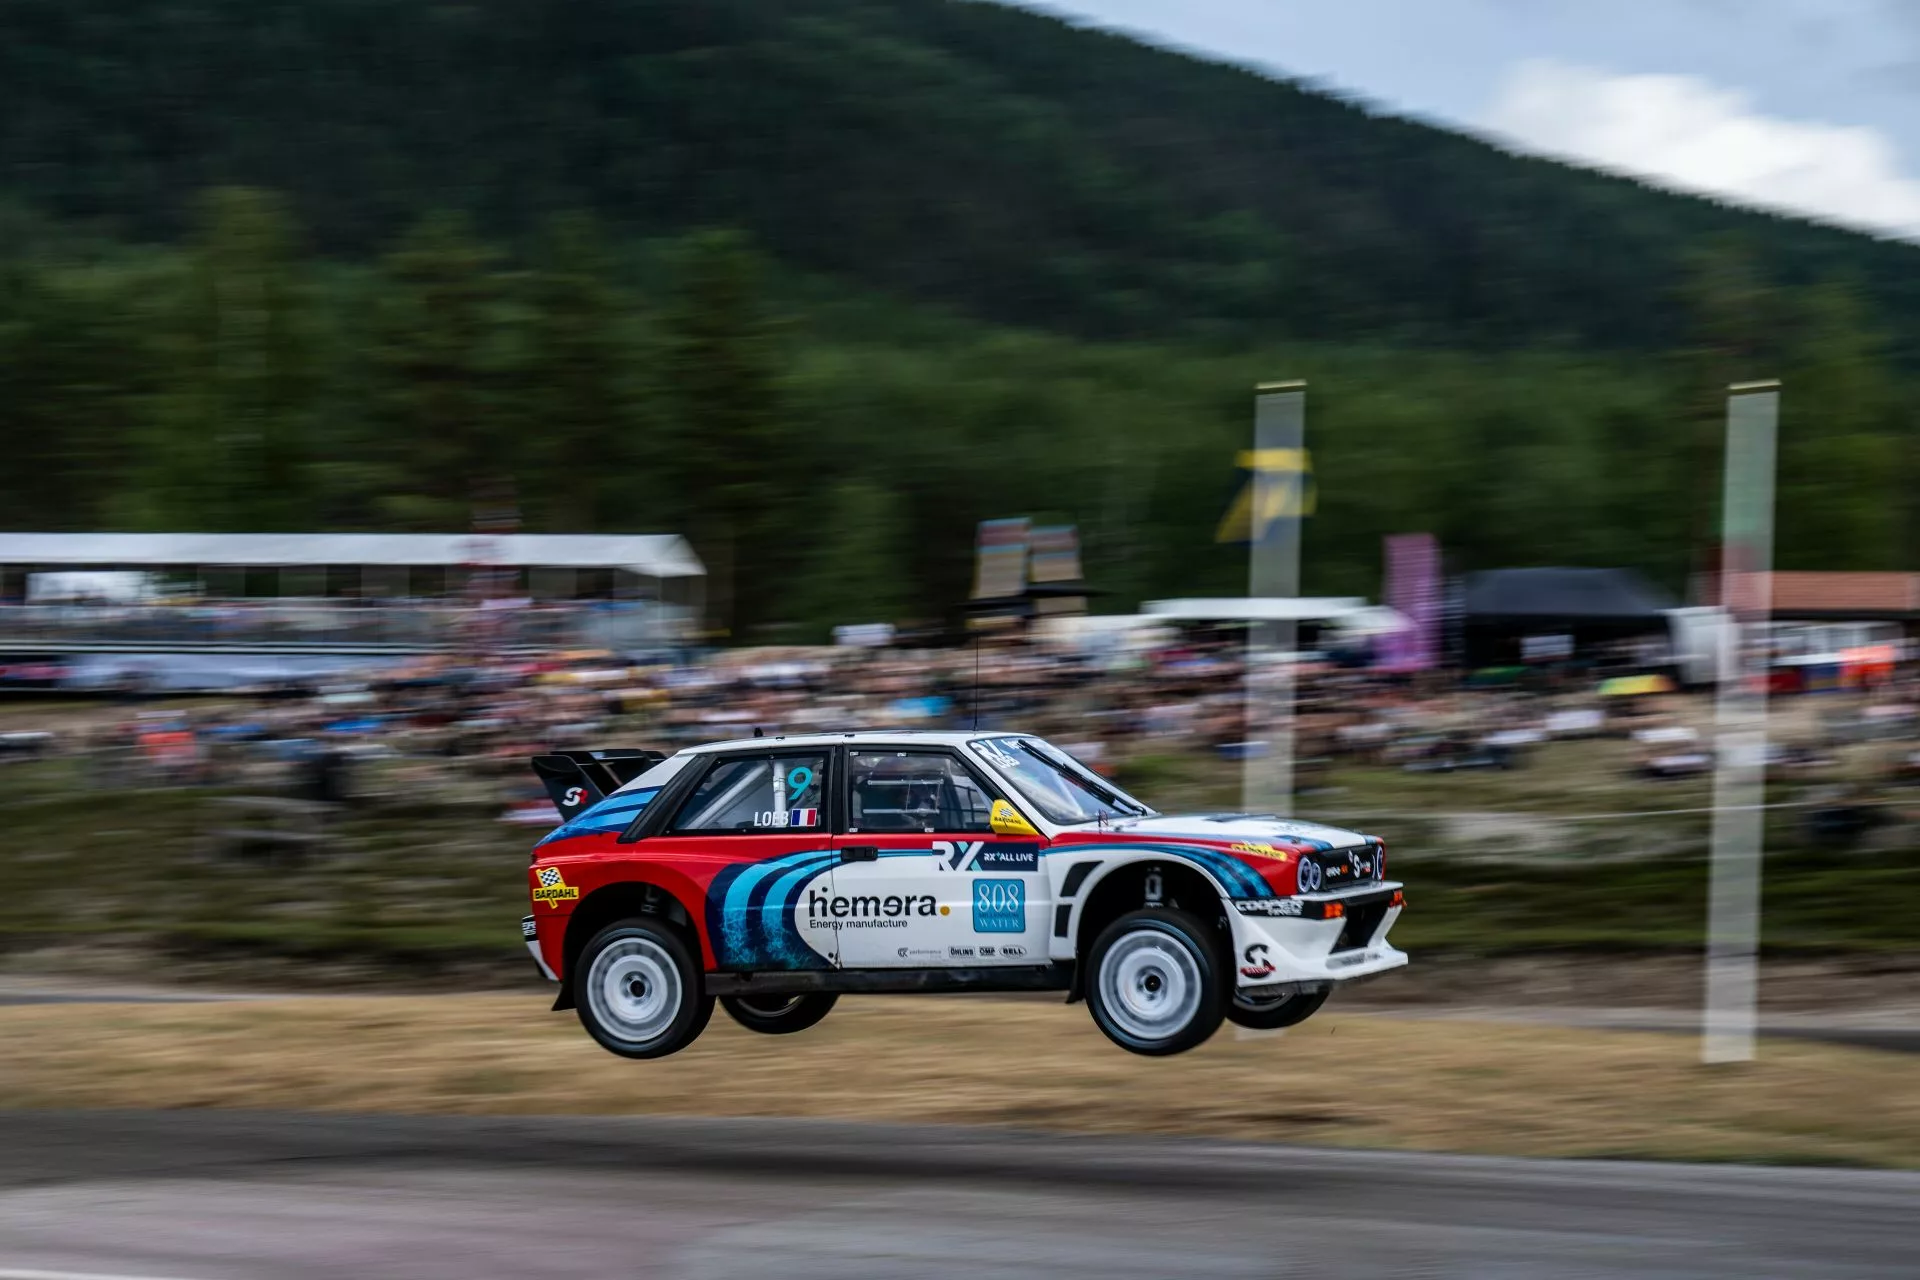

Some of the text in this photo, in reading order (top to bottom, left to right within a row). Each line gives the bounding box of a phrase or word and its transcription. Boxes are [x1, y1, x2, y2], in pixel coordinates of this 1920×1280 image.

[787, 766, 813, 800] 9
[753, 811, 789, 827] LOEB
[932, 841, 984, 871] RX
[1016, 853, 1034, 861] LIVE
[535, 888, 577, 899] BARDAHL
[977, 883, 1019, 913] 808
[809, 919, 908, 930] Energy manufacture
